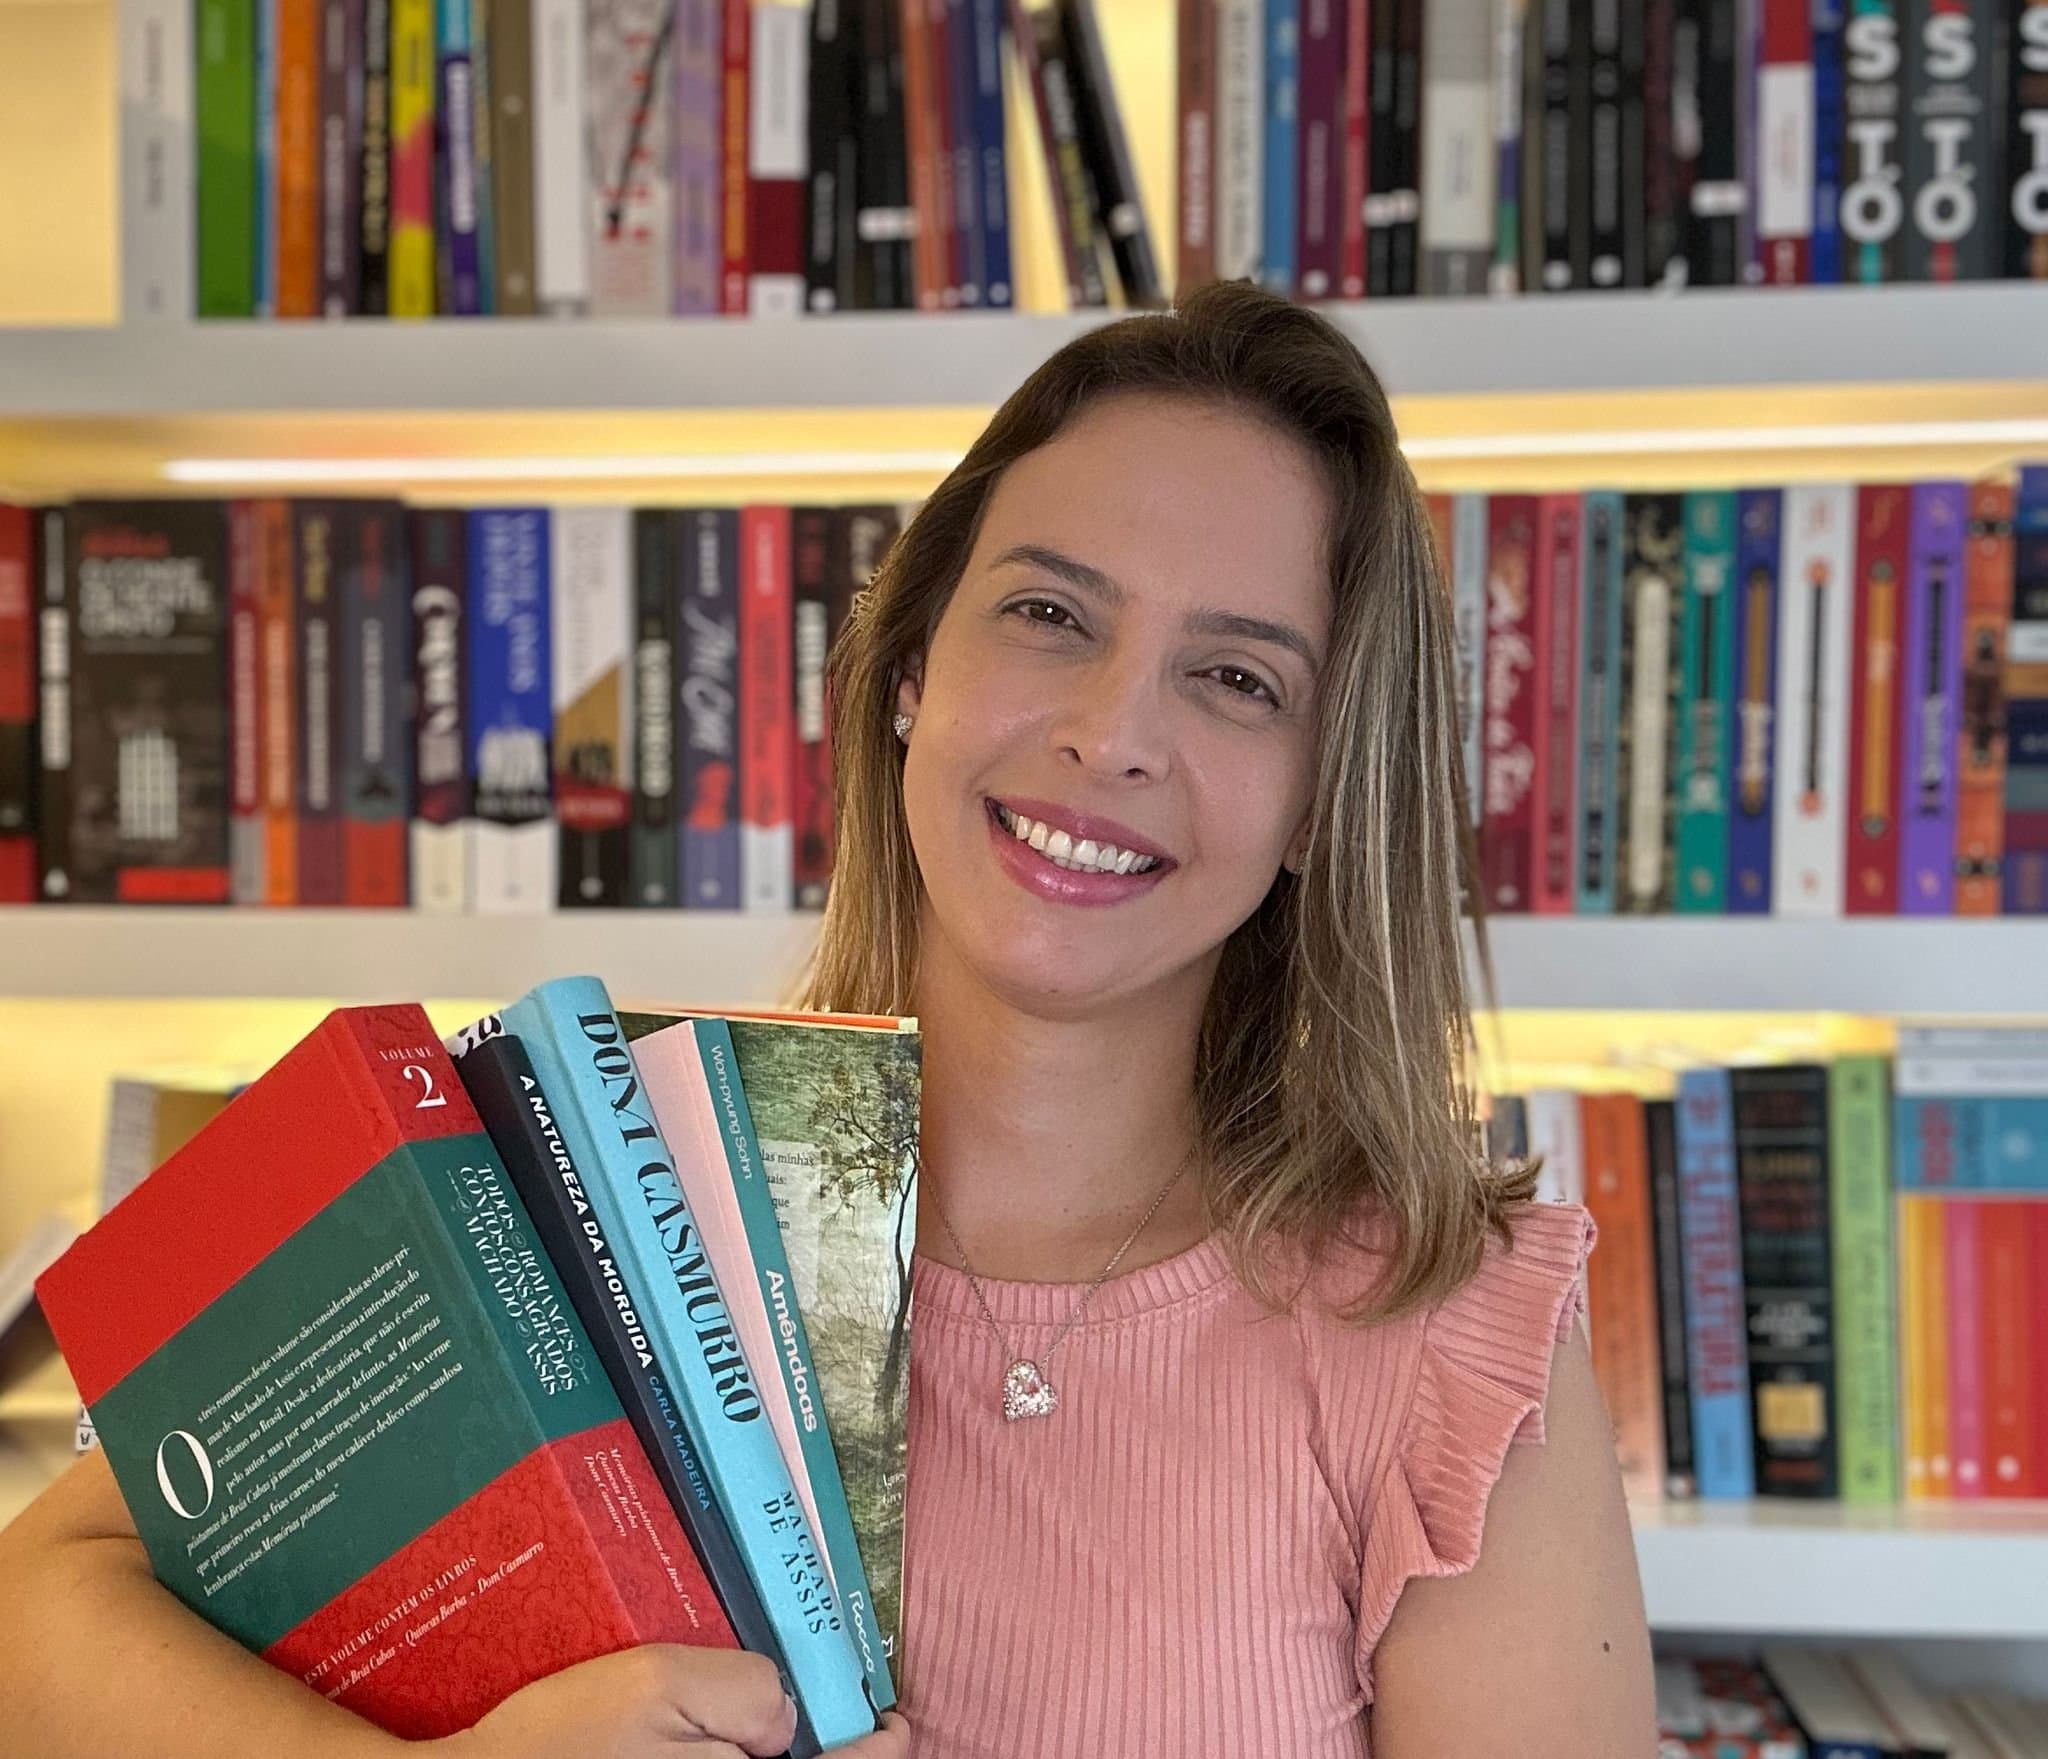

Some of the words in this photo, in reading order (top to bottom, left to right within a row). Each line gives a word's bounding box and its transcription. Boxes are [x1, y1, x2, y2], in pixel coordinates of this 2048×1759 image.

[379, 1046, 435, 1062] VOLUME
[403, 1064, 448, 1109] 2
[519, 1075, 536, 1091] A
[530, 1097, 588, 1215] NATUREZA
[582, 1221, 604, 1253] DA
[598, 1259, 653, 1368] MORDIDA
[735, 1136, 753, 1180] Sohn
[270, 1336, 299, 1363] volume
[312, 1284, 364, 1330] considerados
[466, 1216, 523, 1317] MACHADO
[526, 1343, 561, 1395] ASSIS
[478, 1163, 514, 1230] TODOS
[518, 1250, 578, 1351] ROMANCES
[499, 1247, 578, 1390] CONSAGRADOS
[638, 1162, 760, 1422] CASMURRO
[216, 1438, 250, 1468] realismo
[248, 1429, 261, 1442] no
[284, 1388, 309, 1413] Desde
[362, 1334, 378, 1354] que
[378, 1321, 396, 1338] não
[401, 1293, 431, 1319] escrita
[226, 1471, 244, 1495] pelo
[267, 1439, 285, 1458] mas
[284, 1427, 299, 1448] por
[299, 1415, 316, 1431] um
[315, 1386, 351, 1420] narrador
[387, 1350, 398, 1363] as
[397, 1316, 441, 1352] Memórias
[230, 1394, 266, 1423] Machado
[362, 1279, 408, 1319] introdução
[407, 1269, 420, 1283] do
[766, 1270, 817, 1432] Amêndoas
[156, 1430, 214, 1519] O
[210, 1533, 244, 1567] primeiro
[269, 1497, 290, 1516] frias
[289, 1477, 315, 1501] carnes
[314, 1467, 326, 1481] do
[326, 1453, 345, 1473] meu
[345, 1429, 376, 1458] cadáver
[376, 1407, 405, 1433] dedico
[404, 1389, 429, 1411] como
[429, 1362, 463, 1390] saudosa
[246, 1481, 271, 1504] Cubas
[277, 1448, 313, 1480] mostram
[334, 1411, 361, 1434] traços
[359, 1401, 370, 1415] de
[423, 1339, 451, 1364] verme
[649, 1376, 677, 1430] CARLA
[673, 1434, 710, 1511] MADEIRA
[261, 1519, 300, 1551] Memórias
[763, 1498, 789, 1534] DE
[781, 1552, 826, 1634] ASSIS
[783, 1491, 841, 1631] MACHADO
[330, 1628, 374, 1665] VOLUME
[419, 1584, 435, 1601] OS
[435, 1554, 477, 1590] LIVROS
[369, 1646, 396, 1670] Cubas
[405, 1615, 440, 1647] Quincas
[439, 1595, 467, 1621] Borba
[477, 1572, 501, 1594] Dom
[499, 1542, 544, 1577] Casmurro
[848, 1590, 875, 1673] Rocco
